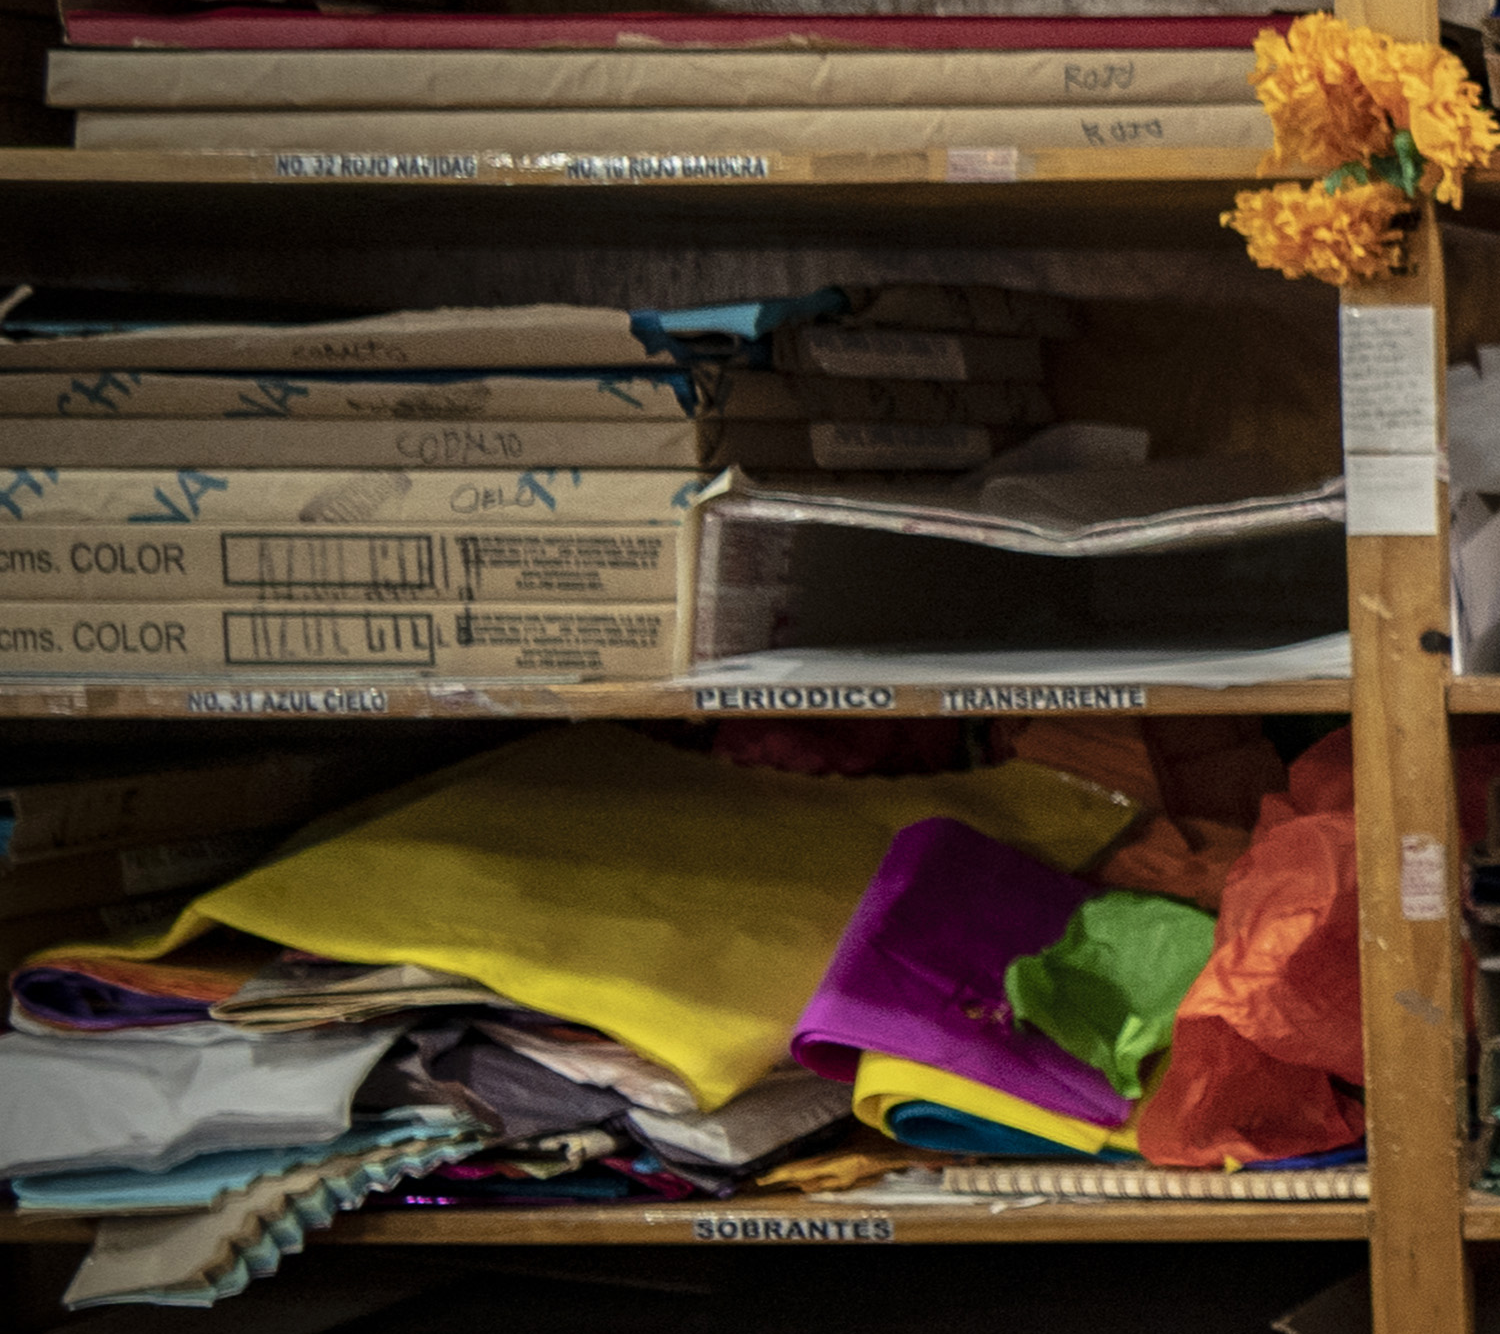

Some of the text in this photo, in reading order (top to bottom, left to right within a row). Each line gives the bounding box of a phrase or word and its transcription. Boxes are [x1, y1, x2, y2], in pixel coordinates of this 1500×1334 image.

[341, 155, 391, 178] ROJO
[629, 156, 677, 178] ROJO
[70, 543, 187, 575] COLOR
[72, 622, 188, 655] COLOR
[187, 688, 388, 712] NO. 31 AZUL CIELO
[695, 687, 895, 709] PERIODICO
[945, 687, 1143, 711] TRANSPARENTE
[694, 1220, 891, 1241] SOBRANTES
